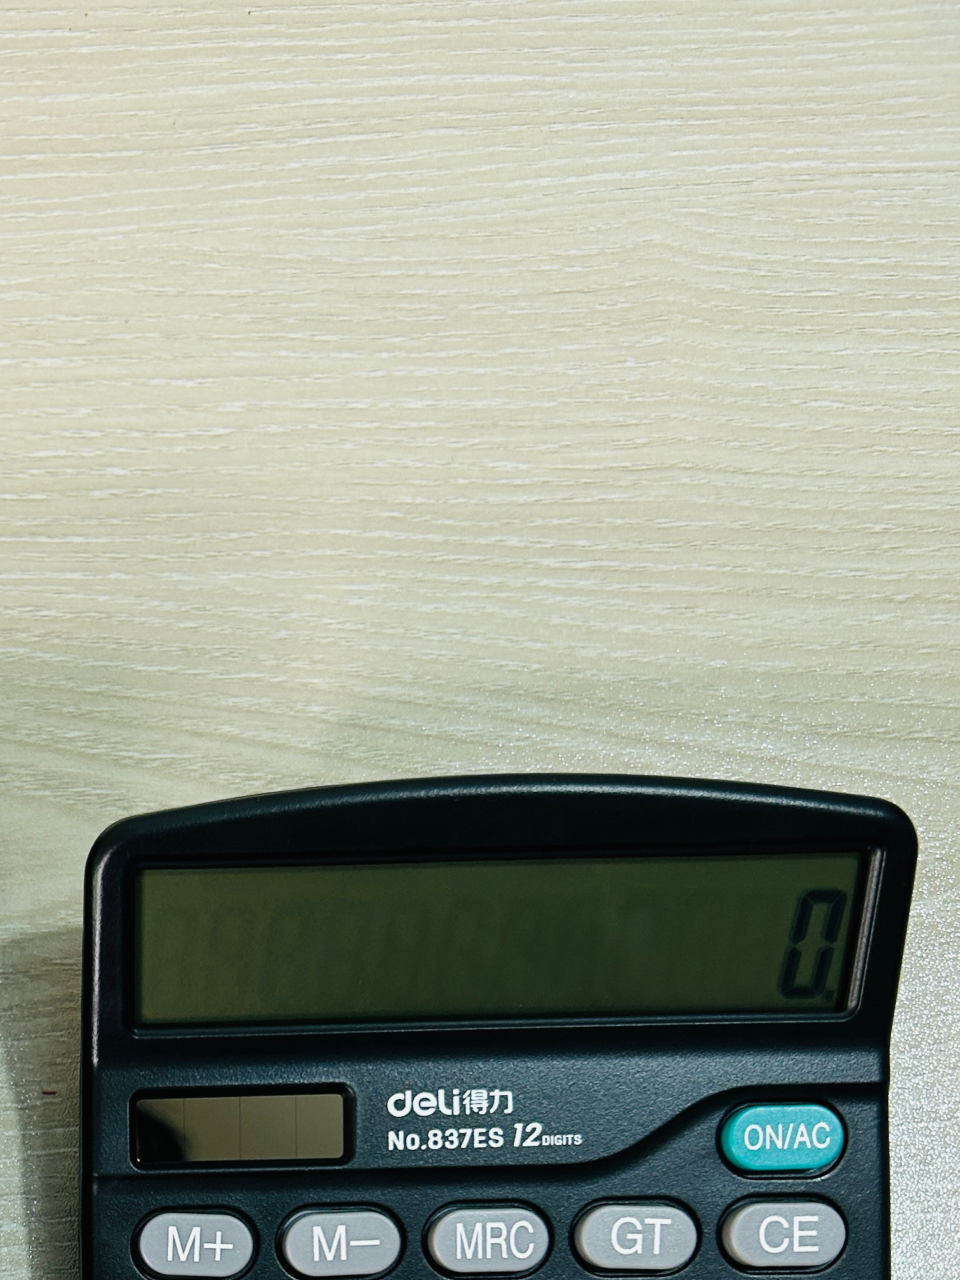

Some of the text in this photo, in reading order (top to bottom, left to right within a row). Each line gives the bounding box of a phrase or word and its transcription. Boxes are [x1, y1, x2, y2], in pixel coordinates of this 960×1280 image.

[387, 1126, 505, 1151] No.837ES
[744, 1121, 831, 1151] ON/AC
[167, 1225, 234, 1263] M+
[455, 1220, 535, 1260] MRC
[610, 1216, 673, 1255] GT
[758, 1214, 820, 1254] CE
